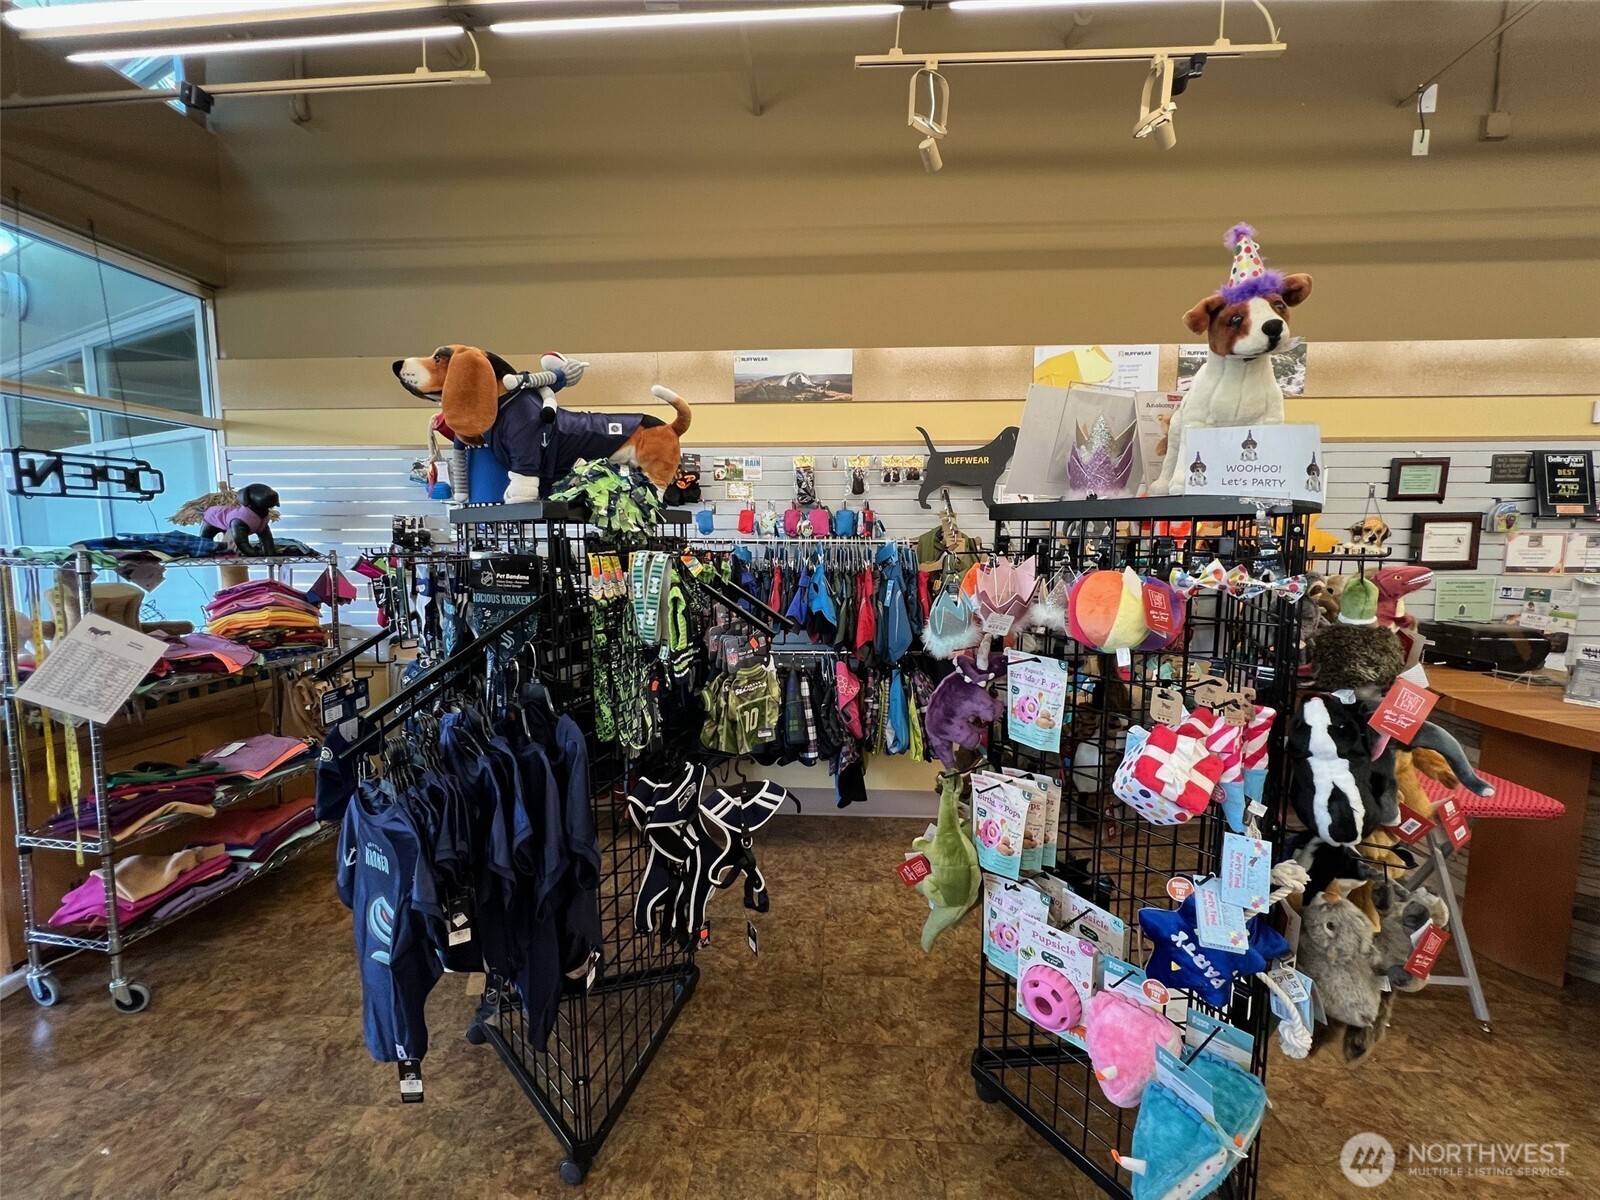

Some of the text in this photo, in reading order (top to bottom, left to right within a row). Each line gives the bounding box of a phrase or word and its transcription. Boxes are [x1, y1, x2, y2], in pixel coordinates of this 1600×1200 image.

[1146, 402, 1175, 410] Anatomy
[944, 456, 990, 465] RUFFWEAR
[1548, 455, 1584, 464] Bellingham
[1226, 464, 1282, 473] WOOHOO!
[1221, 478, 1286, 487] Let's PARTY
[506, 573, 530, 581] Bandana
[501, 593, 531, 605] KRAKEN
[743, 707, 759, 733] 10
[1004, 805, 1021, 819] Pops
[1071, 903, 1110, 931] Pupsicle
[1113, 918, 1122, 927] XL
[1032, 930, 1076, 957] Pupsicle
[1080, 943, 1090, 952] XL
[1170, 930, 1226, 989] PARTY
